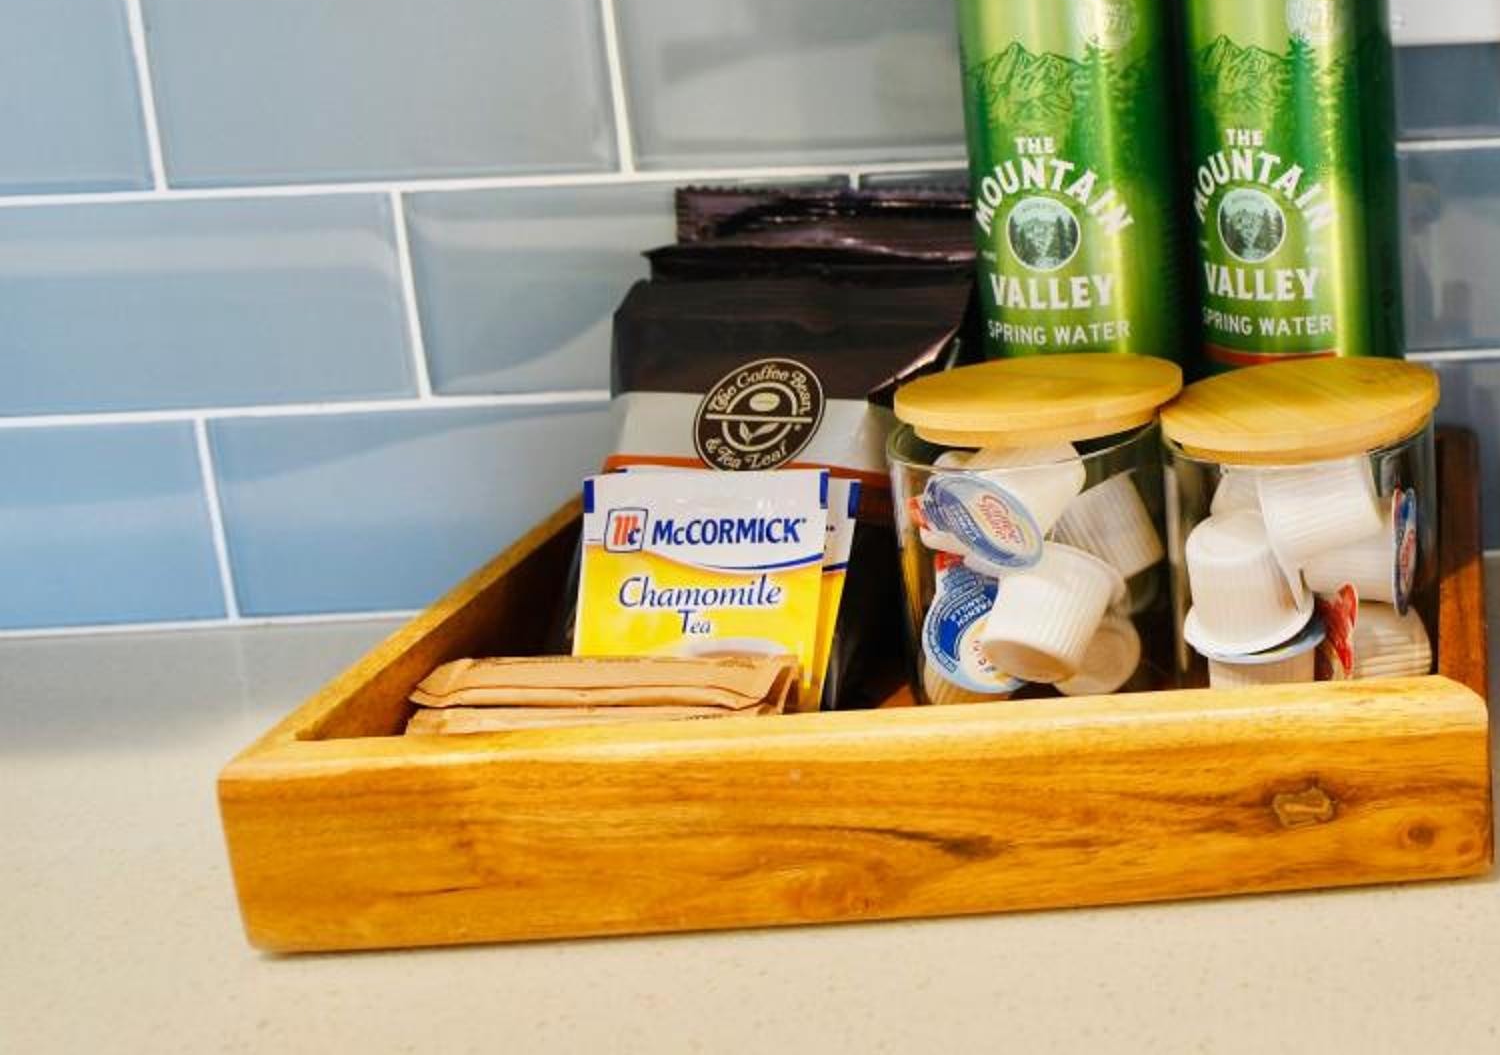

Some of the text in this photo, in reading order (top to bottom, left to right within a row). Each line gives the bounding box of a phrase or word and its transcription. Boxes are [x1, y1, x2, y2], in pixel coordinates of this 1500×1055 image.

[1015, 136, 1056, 155] THE
[1225, 129, 1264, 146] THE
[975, 157, 1135, 237] MOUNTAIN
[1194, 148, 1334, 233] MOUNTAIN
[989, 272, 1117, 311] VALLEY
[1204, 260, 1320, 302] VALLEY
[987, 319, 1132, 346] SPRING WATER
[1202, 306, 1334, 337] SPRING WATER
[736, 365, 788, 388] Coffee
[790, 370, 812, 415] Bean
[744, 439, 787, 469] Leaf
[651, 518, 803, 546] McCORMICK
[618, 573, 782, 608] Chamomile
[677, 609, 712, 635] Tea
